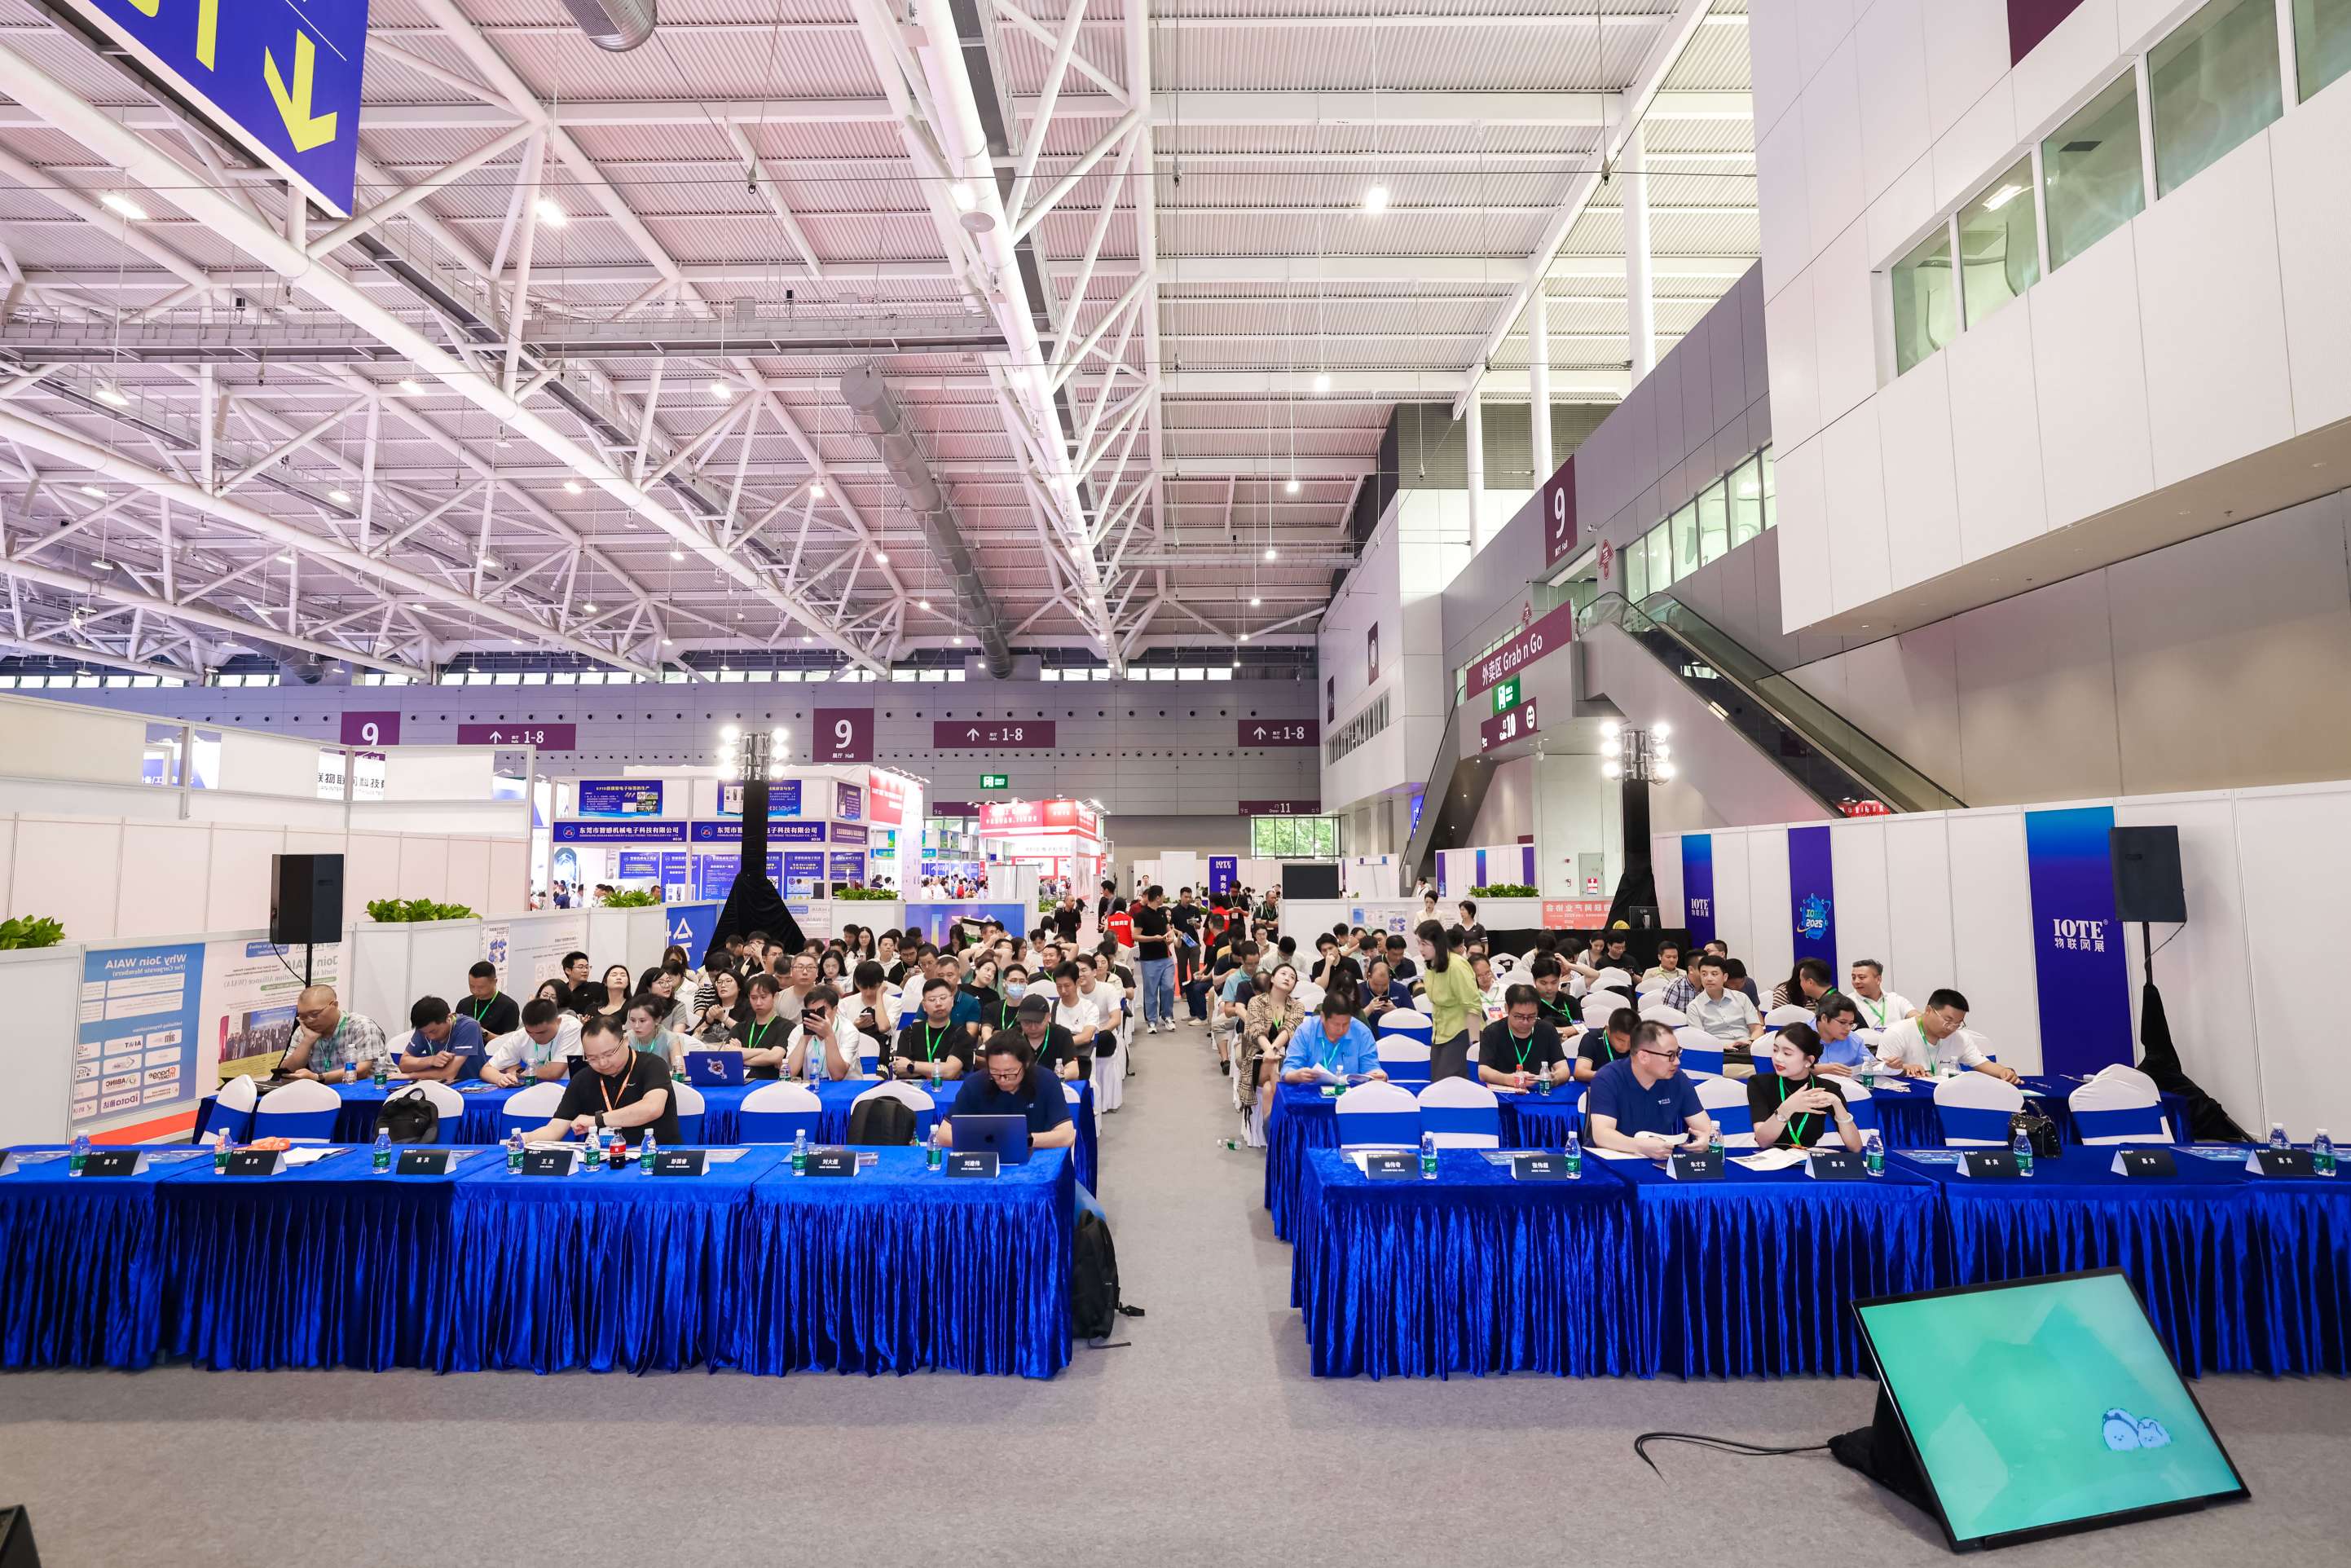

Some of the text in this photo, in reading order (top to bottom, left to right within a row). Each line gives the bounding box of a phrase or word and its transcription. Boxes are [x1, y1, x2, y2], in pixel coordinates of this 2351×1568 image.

[1554, 487, 1565, 539] 9
[1481, 633, 1543, 686] 外卖区 Grab n Go
[1283, 726, 1304, 739] 1-8
[1506, 713, 1516, 738] 10
[362, 722, 379, 746] 9
[524, 731, 544, 744] 1-8
[835, 720, 852, 748] 9
[1002, 728, 1023, 741] 1-8
[1280, 803, 1290, 813] 11
[1691, 898, 1709, 910] IOTE
[1806, 918, 1823, 928] 2025
[2053, 918, 2104, 940] IOTE
[2054, 937, 2105, 952] 物联网展
